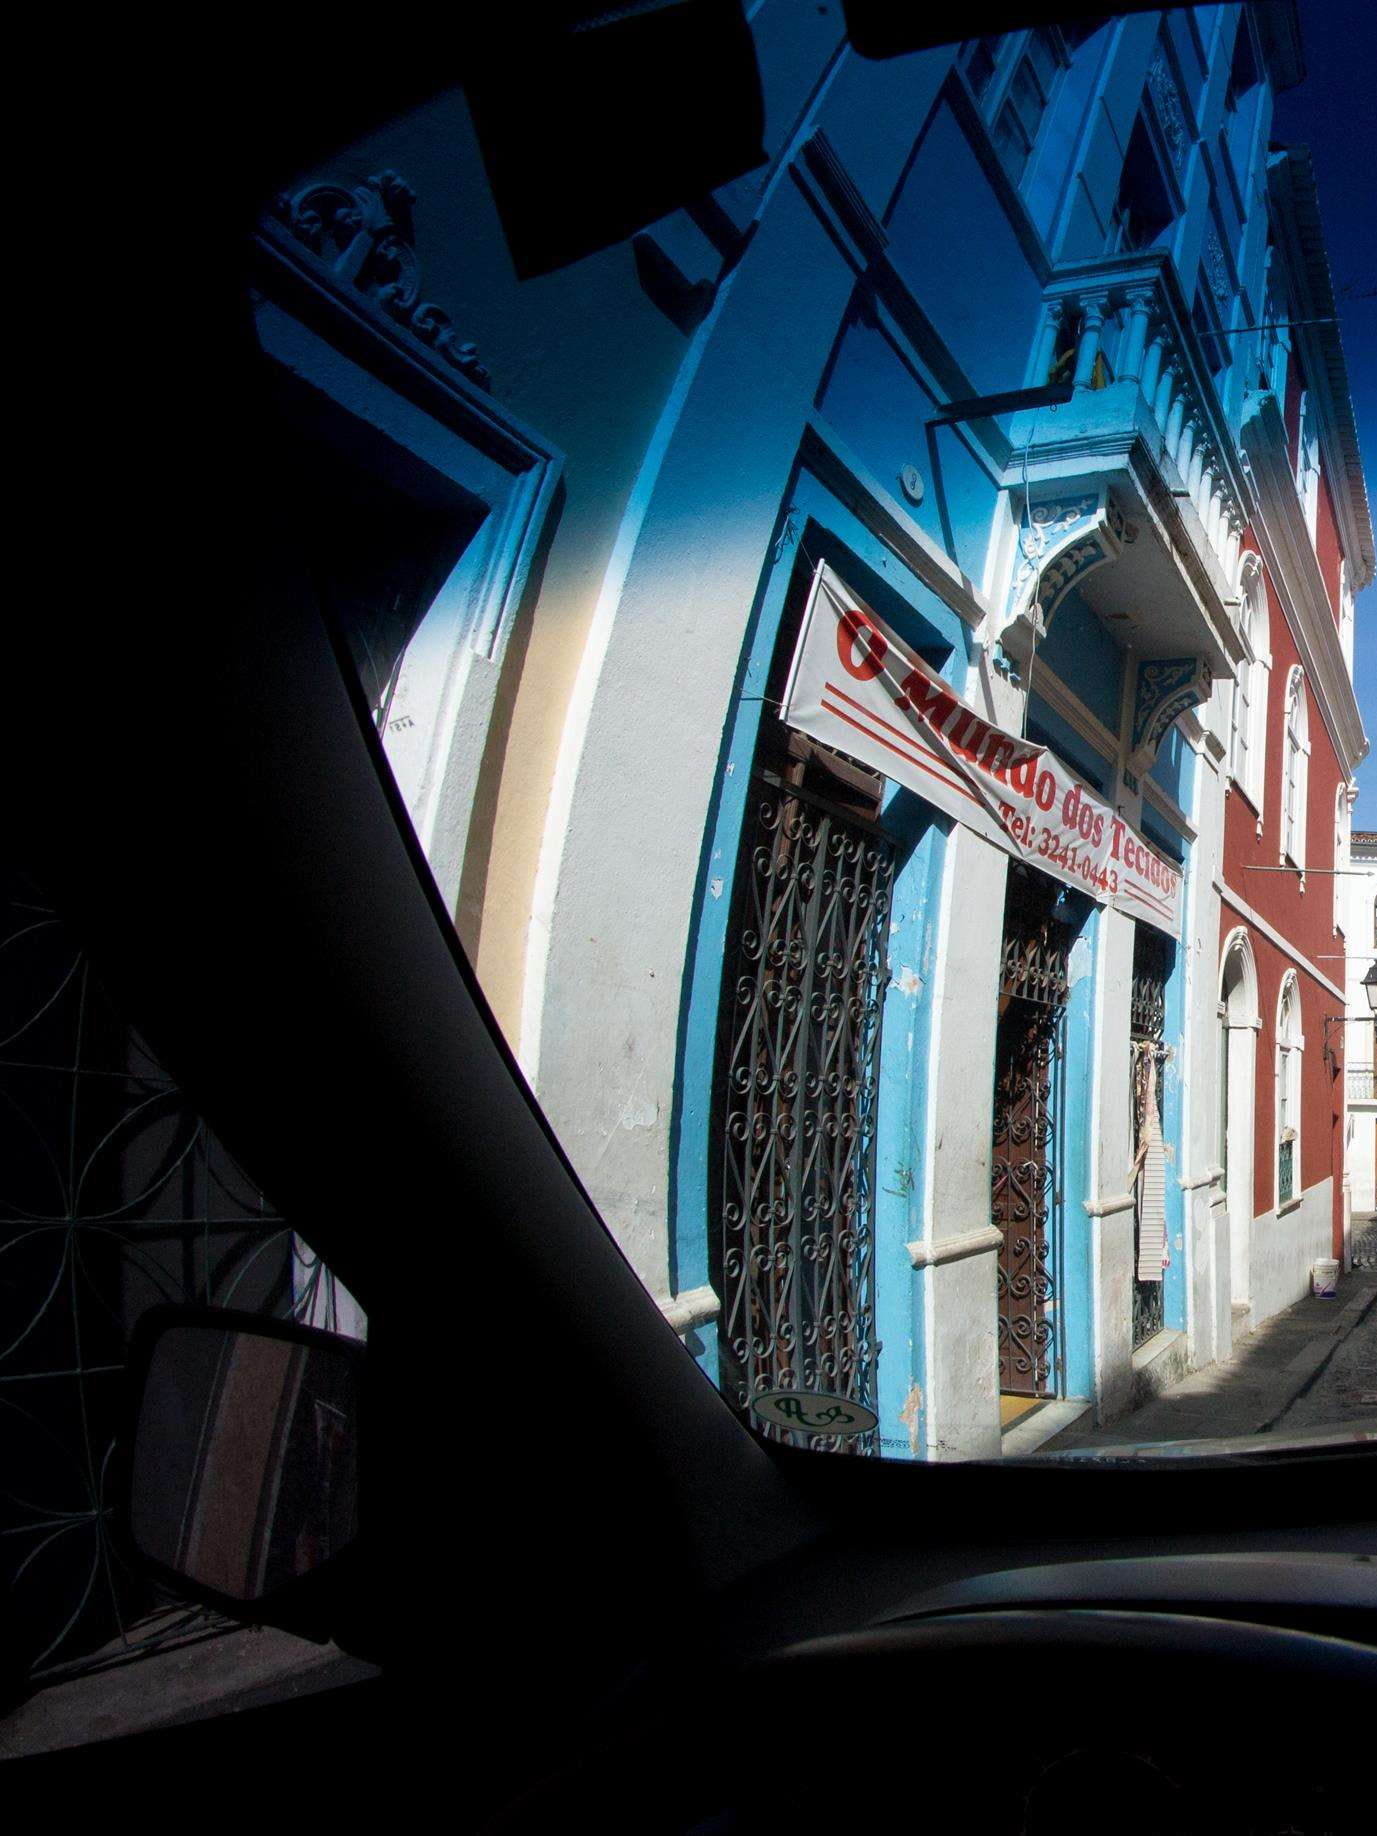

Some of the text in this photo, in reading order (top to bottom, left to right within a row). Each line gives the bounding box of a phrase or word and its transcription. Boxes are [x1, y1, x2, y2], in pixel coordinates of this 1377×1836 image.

[836, 609, 1178, 899] O Mundo dos Tecidos
[998, 800, 1119, 894] Tel: 3241-0443
